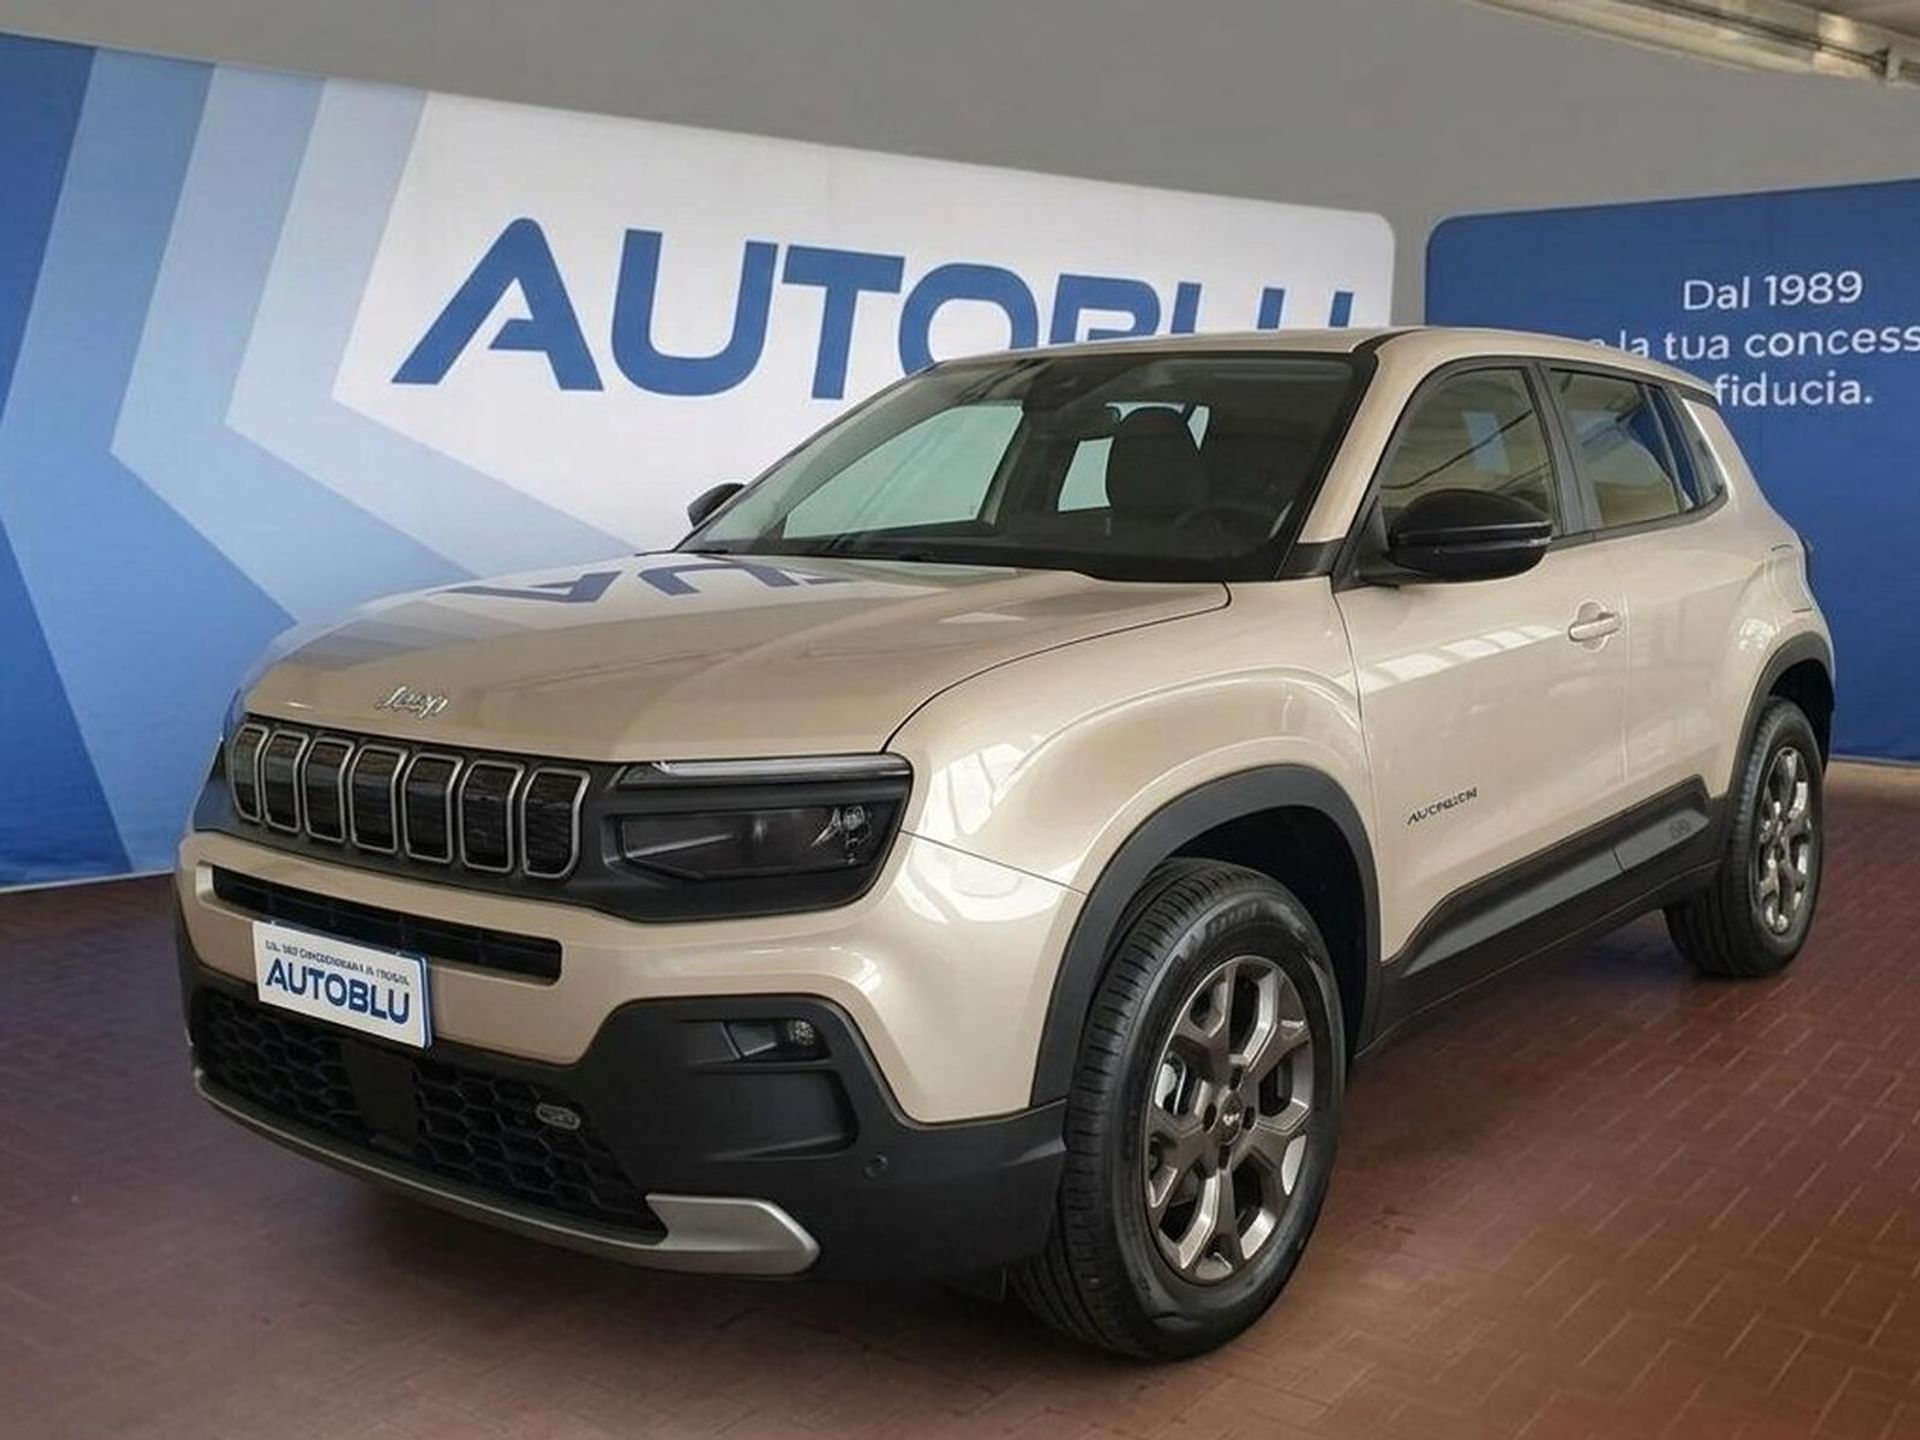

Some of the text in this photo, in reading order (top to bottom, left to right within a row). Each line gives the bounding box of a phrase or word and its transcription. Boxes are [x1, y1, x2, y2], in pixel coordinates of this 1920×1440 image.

[1683, 270, 1863, 310] Dal 1989
[1664, 331, 1729, 360] tua
[1744, 325, 1920, 358] concess
[1714, 369, 1873, 407] fiducia.
[265, 957, 410, 1025] AUTOBLU
